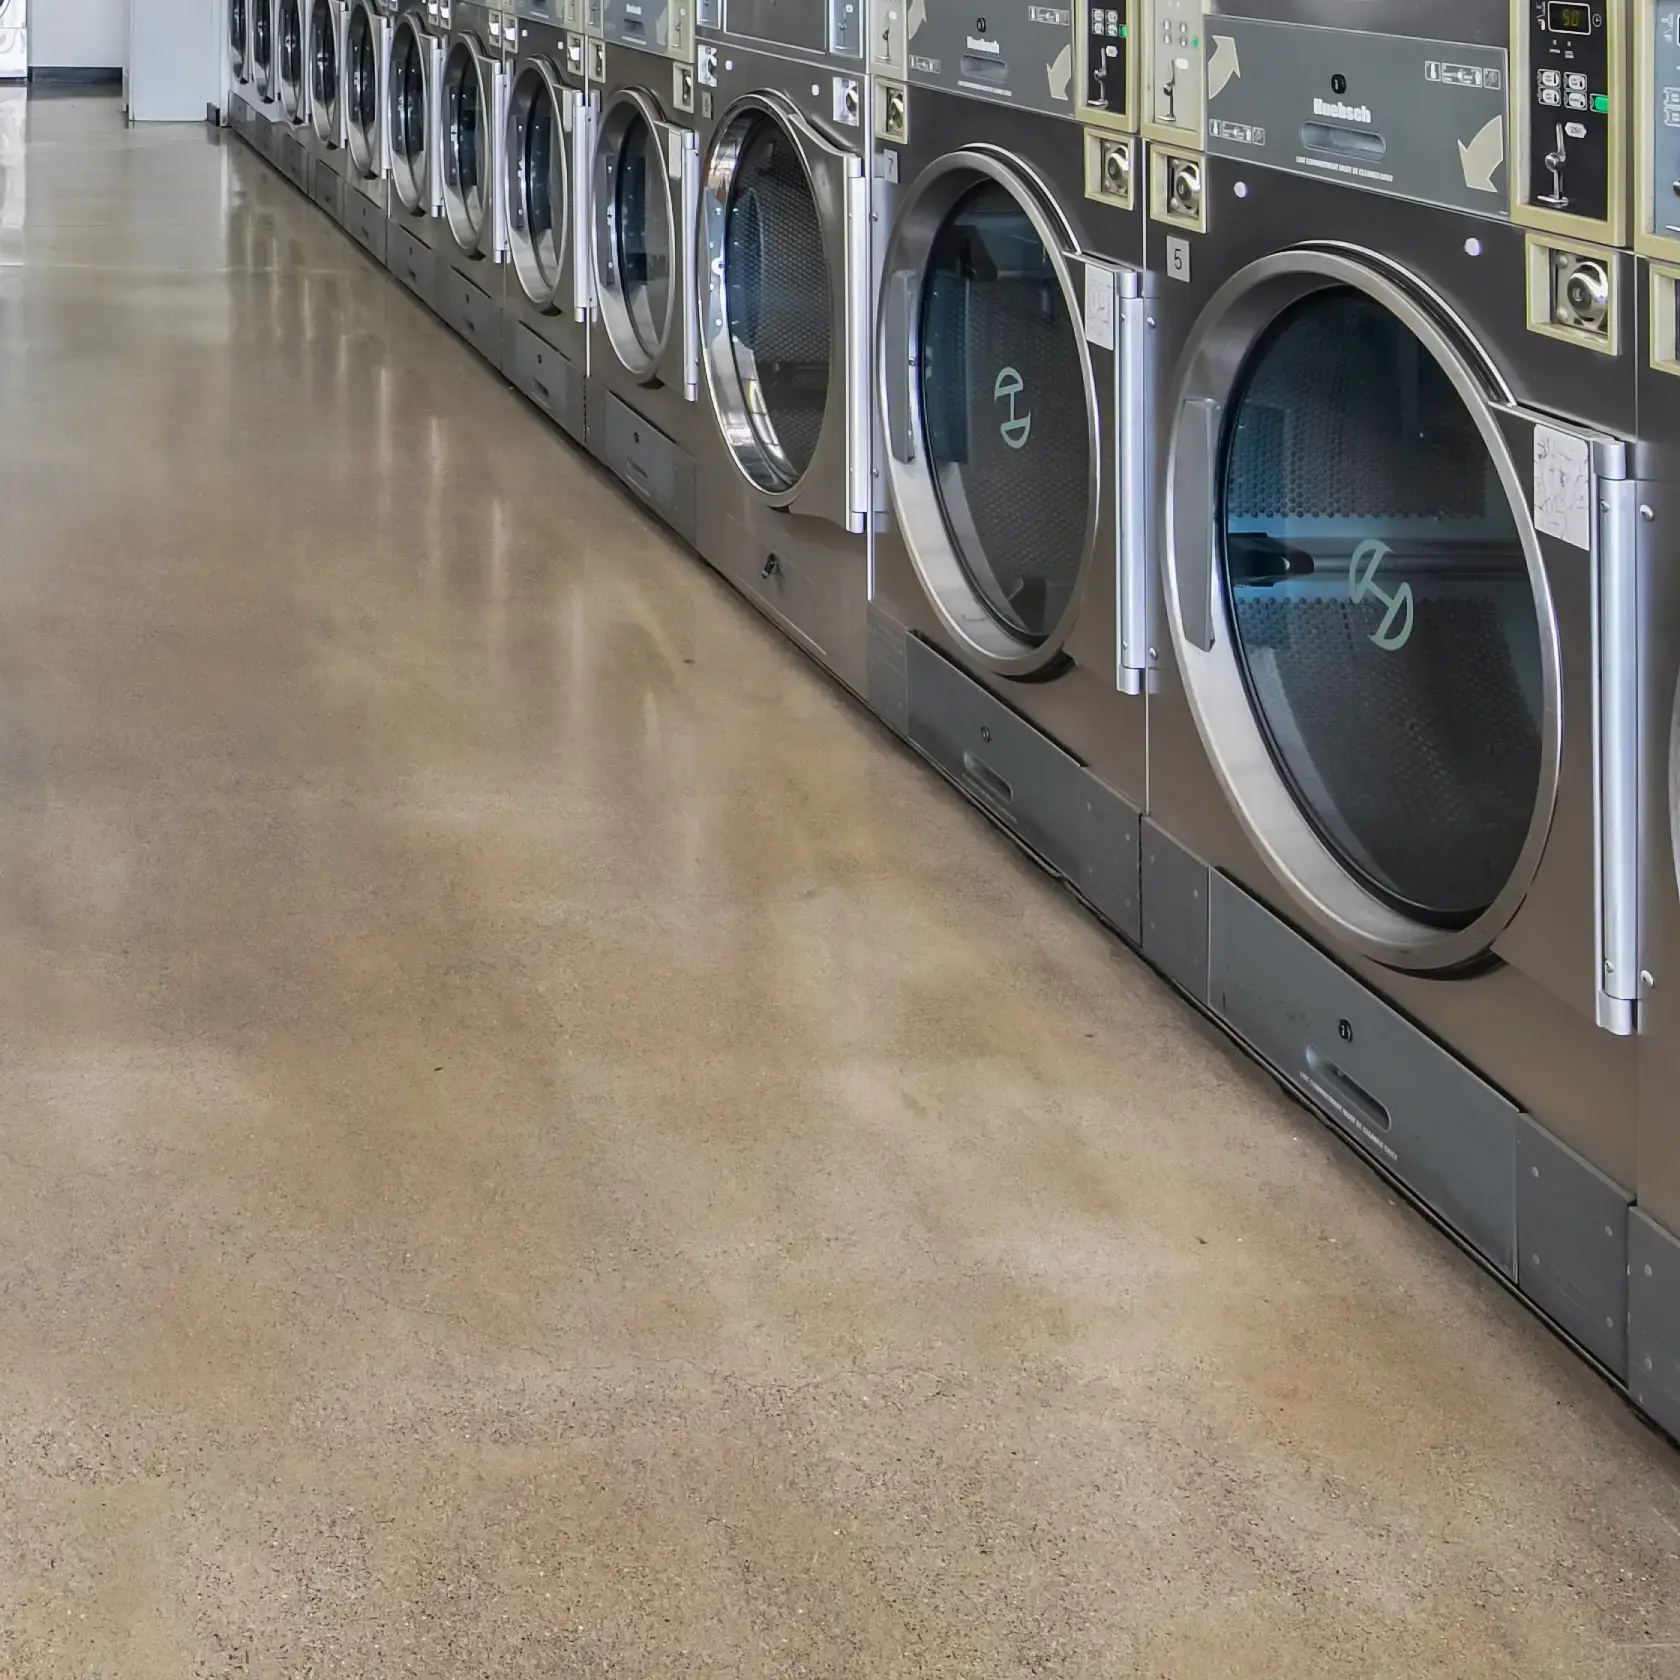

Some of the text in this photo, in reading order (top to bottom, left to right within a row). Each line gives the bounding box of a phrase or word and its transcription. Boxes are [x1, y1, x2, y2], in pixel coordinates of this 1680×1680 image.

[1562, 9, 1580, 27] 50
[1313, 97, 1372, 124] Huebsch
[888, 157, 897, 175] 7
[1173, 248, 1182, 271] 5
